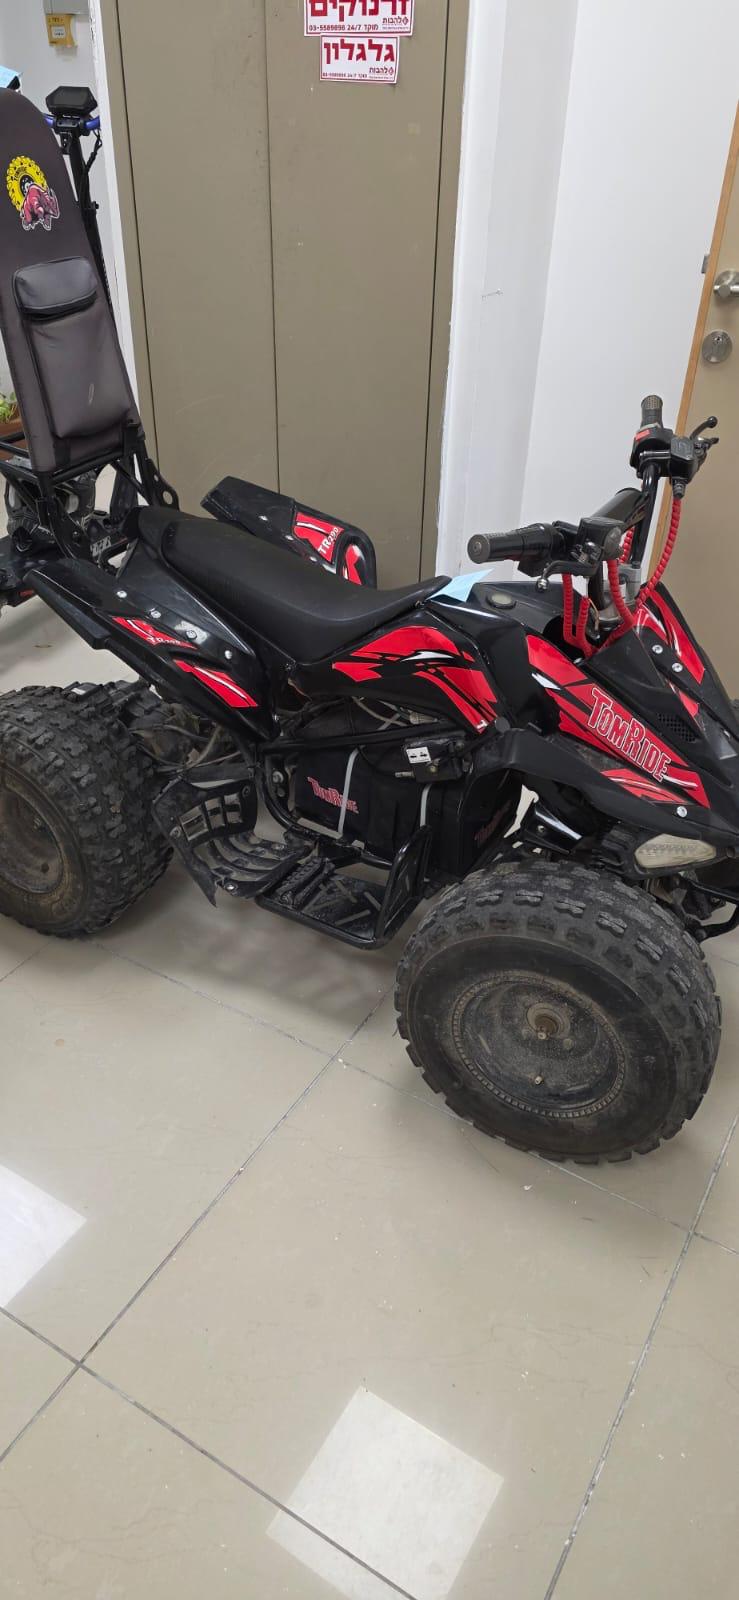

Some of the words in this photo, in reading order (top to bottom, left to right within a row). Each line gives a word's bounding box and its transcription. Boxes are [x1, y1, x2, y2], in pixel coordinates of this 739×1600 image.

[309, 0, 409, 22] זרנוקים
[364, 24, 379, 32] מוקד
[382, 16, 402, 25] להבות
[323, 38, 395, 64] גלגלון
